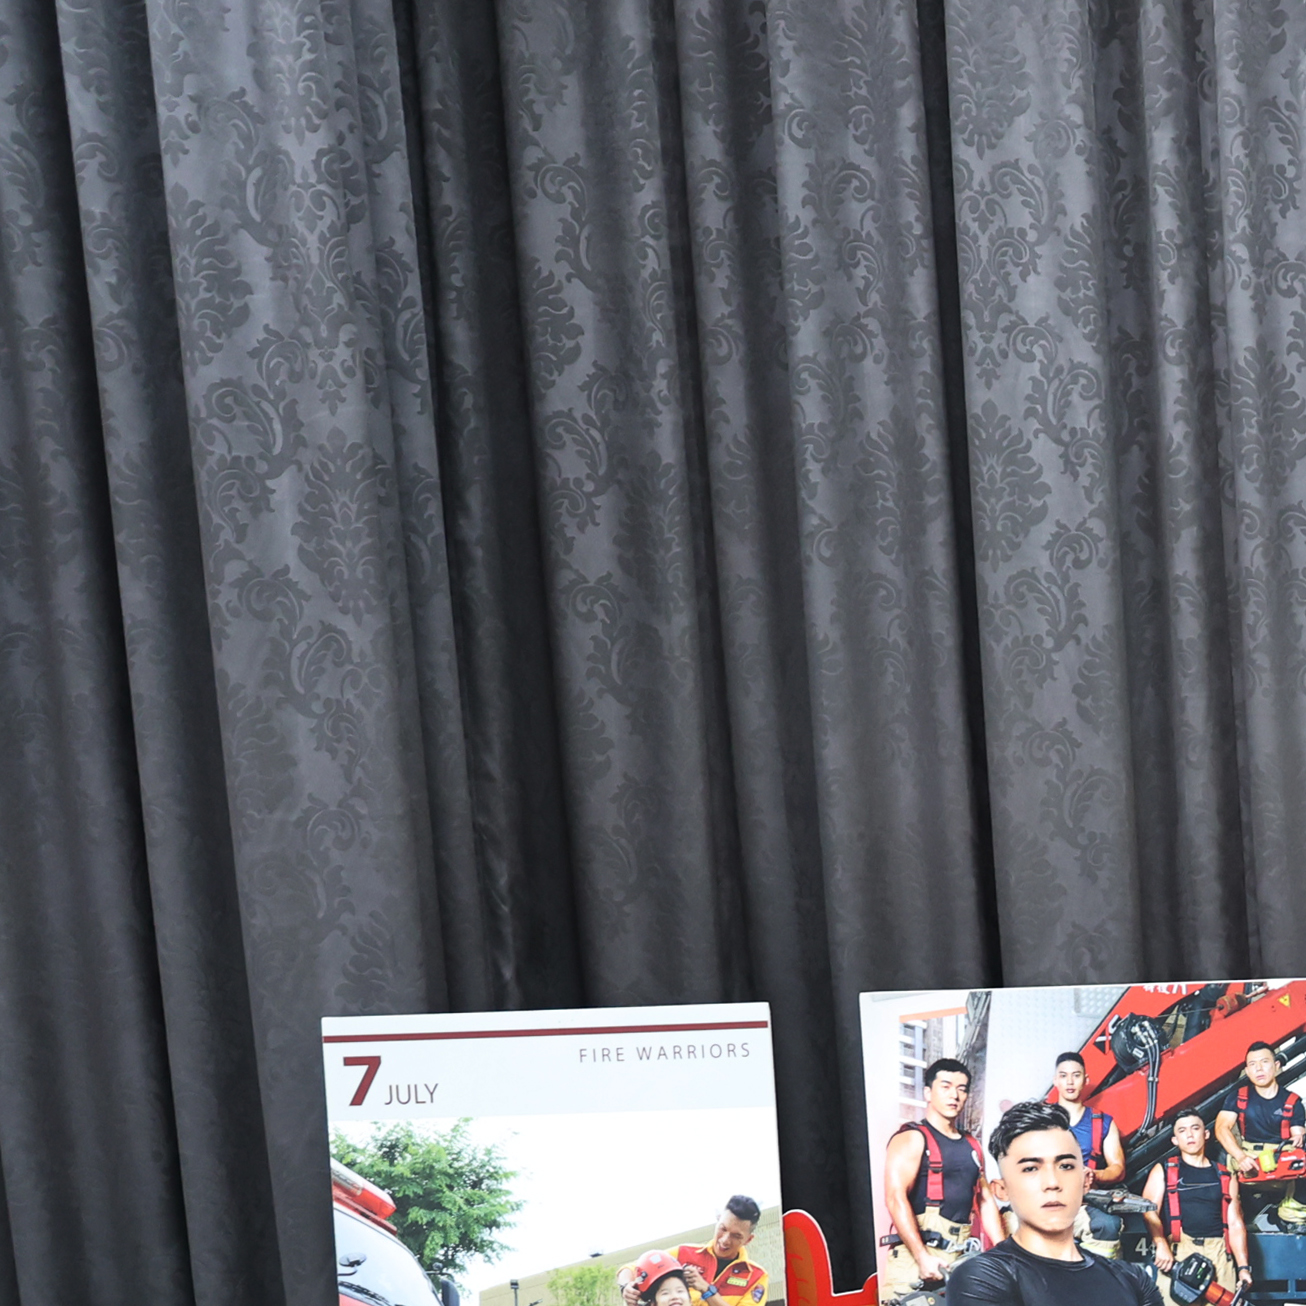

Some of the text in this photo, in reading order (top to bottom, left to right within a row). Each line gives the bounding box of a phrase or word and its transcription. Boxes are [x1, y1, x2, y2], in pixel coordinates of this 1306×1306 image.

[579, 1042, 750, 1063] FIRE WARRIORS
[342, 1055, 439, 1106] 7 JULY
